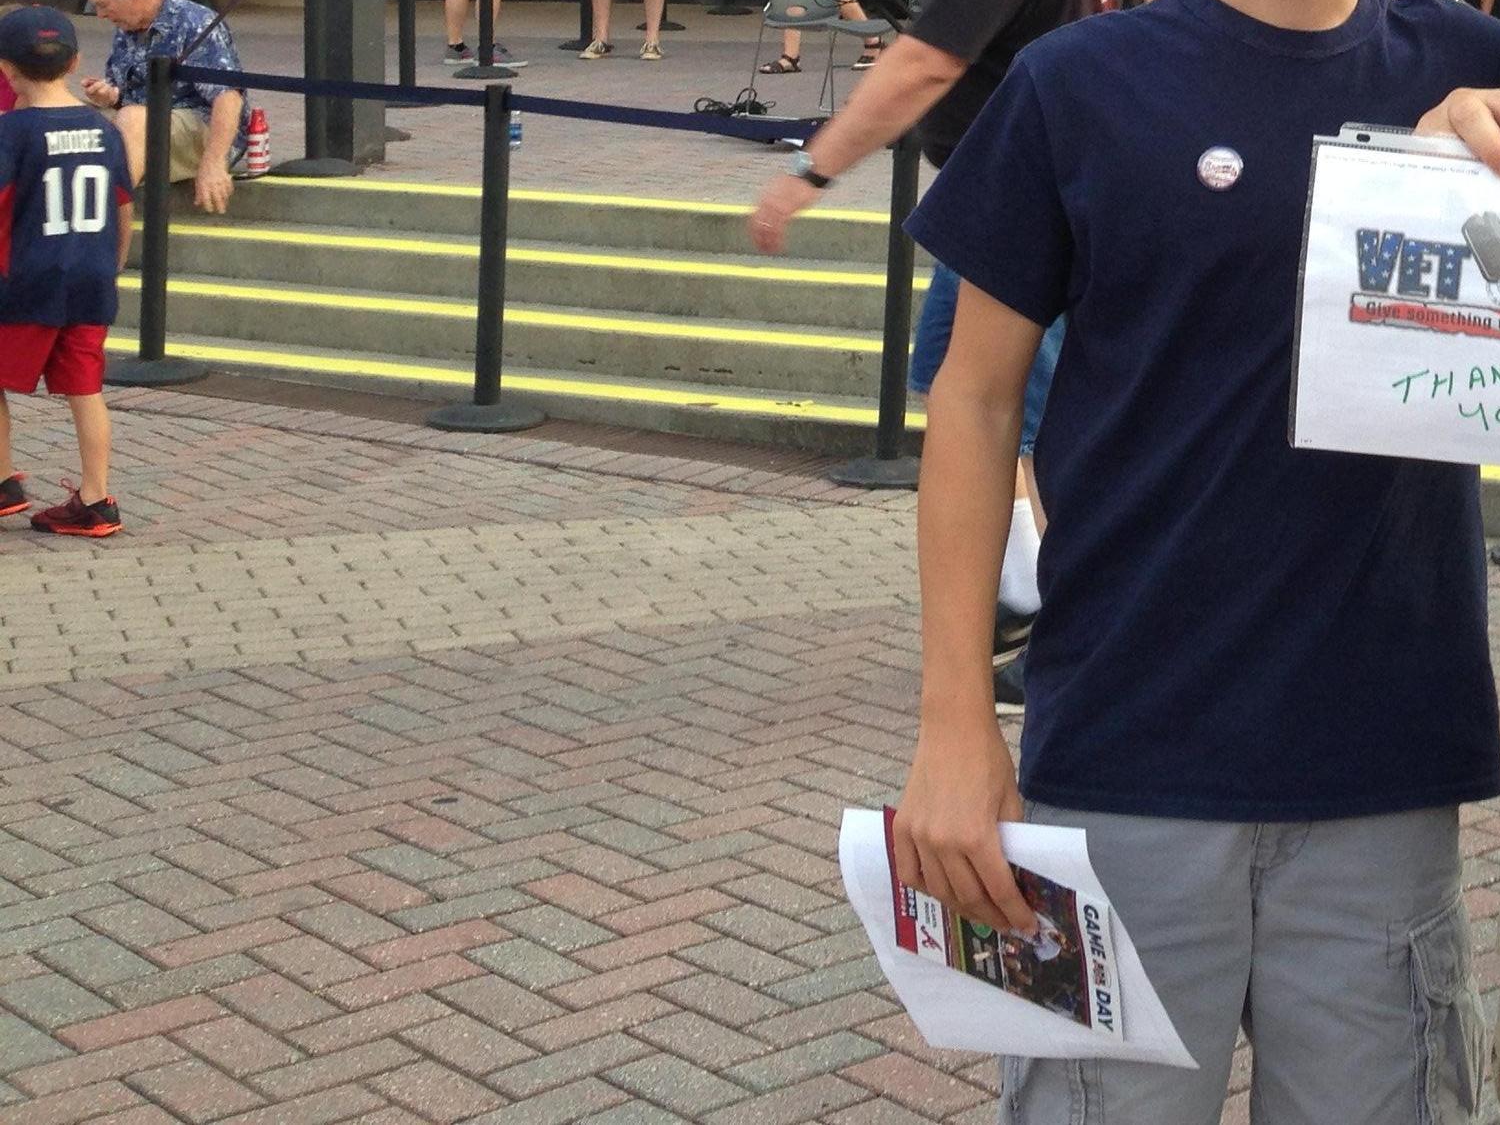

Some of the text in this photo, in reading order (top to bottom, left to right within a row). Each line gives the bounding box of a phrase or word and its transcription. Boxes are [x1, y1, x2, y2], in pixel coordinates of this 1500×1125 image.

[42, 164, 110, 237] 10
[1356, 228, 1474, 301] VET
[1366, 301, 1399, 320] Give
[1407, 306, 1492, 332] something
[1083, 903, 1107, 961] GAME
[1095, 987, 1114, 1033] DAY
